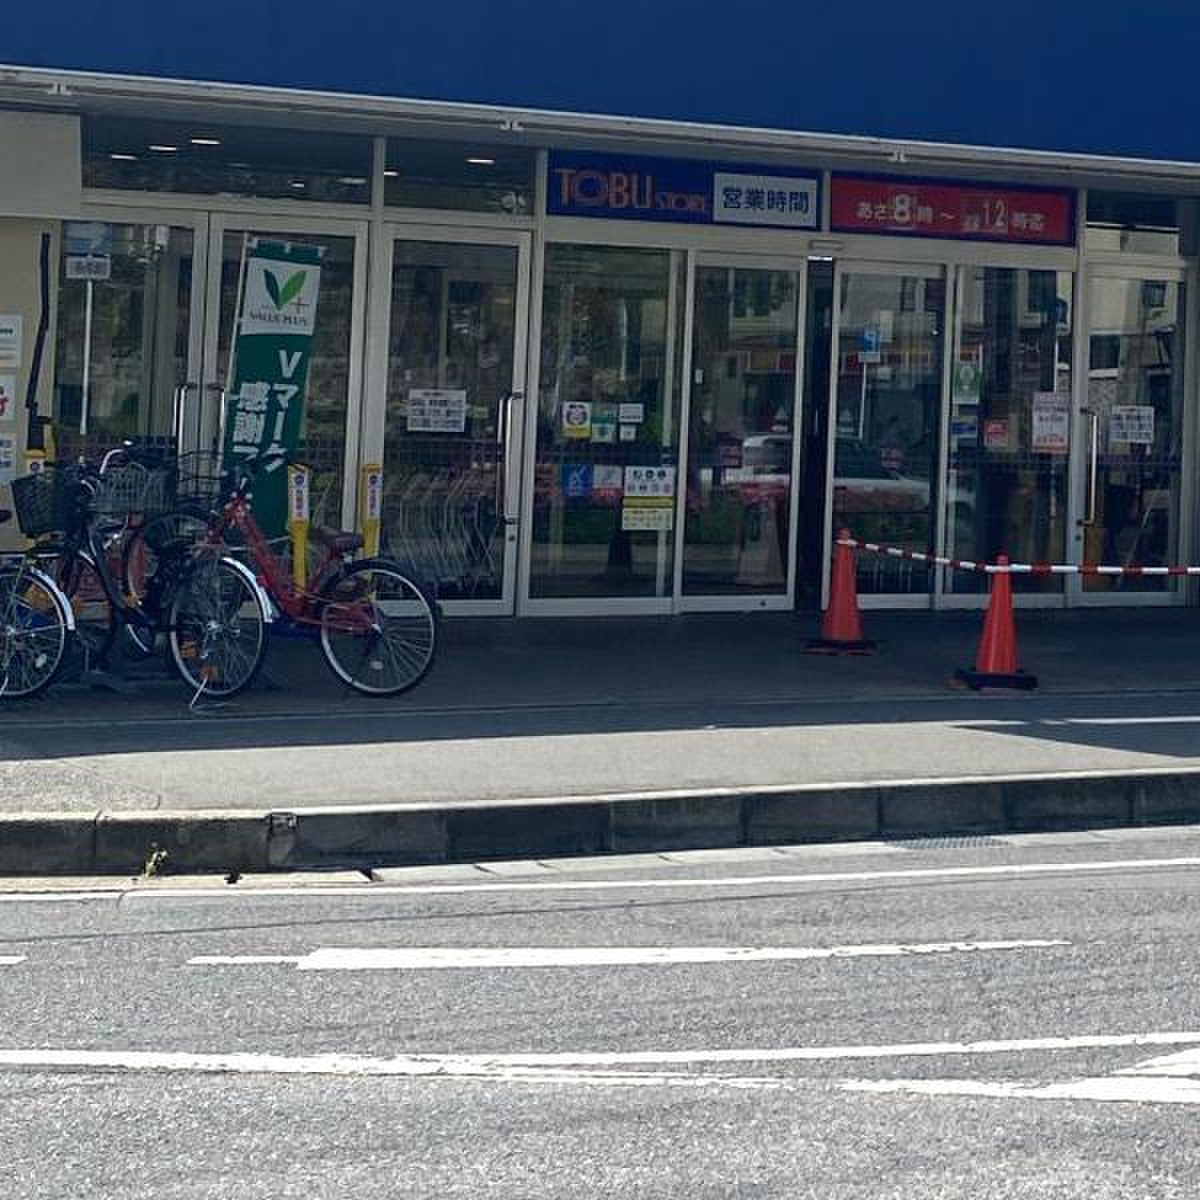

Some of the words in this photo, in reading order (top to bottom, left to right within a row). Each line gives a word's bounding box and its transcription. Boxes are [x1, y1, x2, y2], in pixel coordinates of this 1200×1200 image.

[555, 167, 654, 210] TOBU
[722, 186, 809, 213] 営業時間
